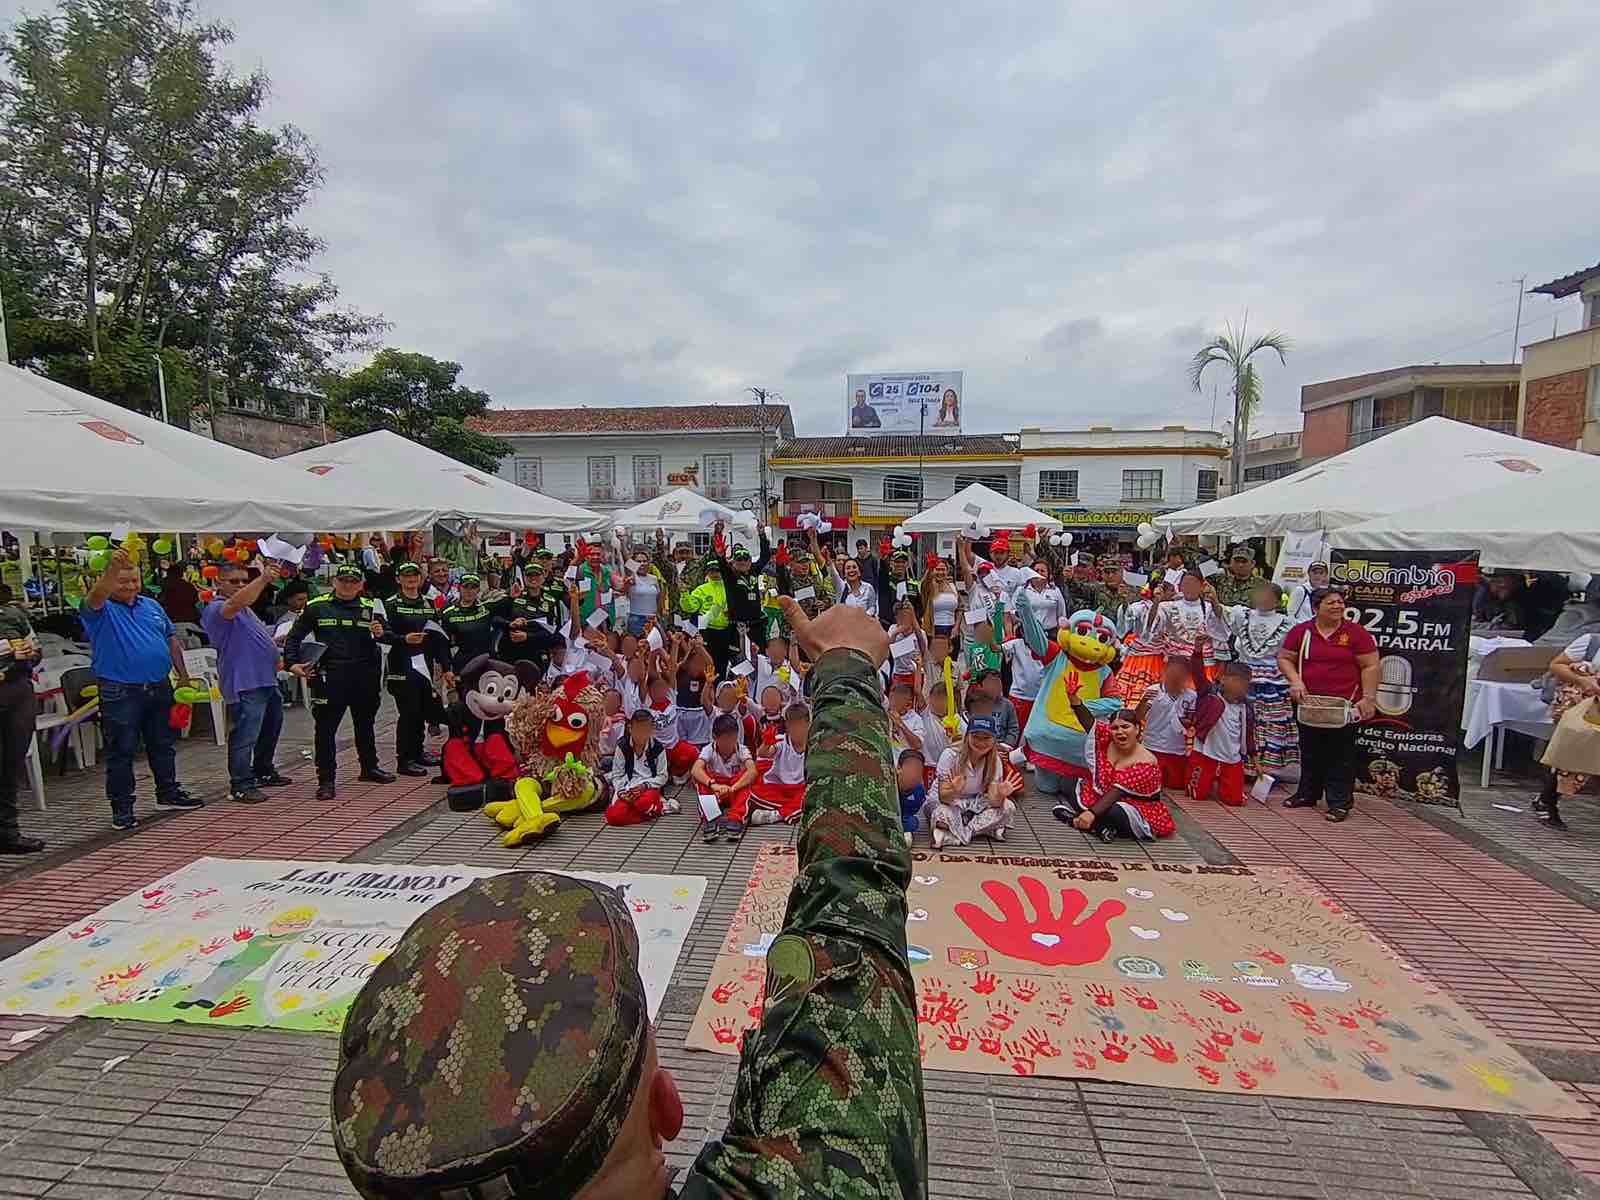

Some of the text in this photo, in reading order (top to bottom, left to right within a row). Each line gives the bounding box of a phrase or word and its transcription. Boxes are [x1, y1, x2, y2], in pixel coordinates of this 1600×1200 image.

[885, 384, 899, 394] 25
[919, 383, 941, 394] 104
[1330, 562, 1456, 589] Colombia
[1343, 606, 1452, 636] 92.5 FM
[1373, 635, 1456, 651] PARRAL
[1364, 727, 1381, 737] de
[1384, 730, 1445, 742] Emisoras
[1356, 736, 1456, 756] ército Nacional
[278, 868, 464, 892] LAS MANOS
